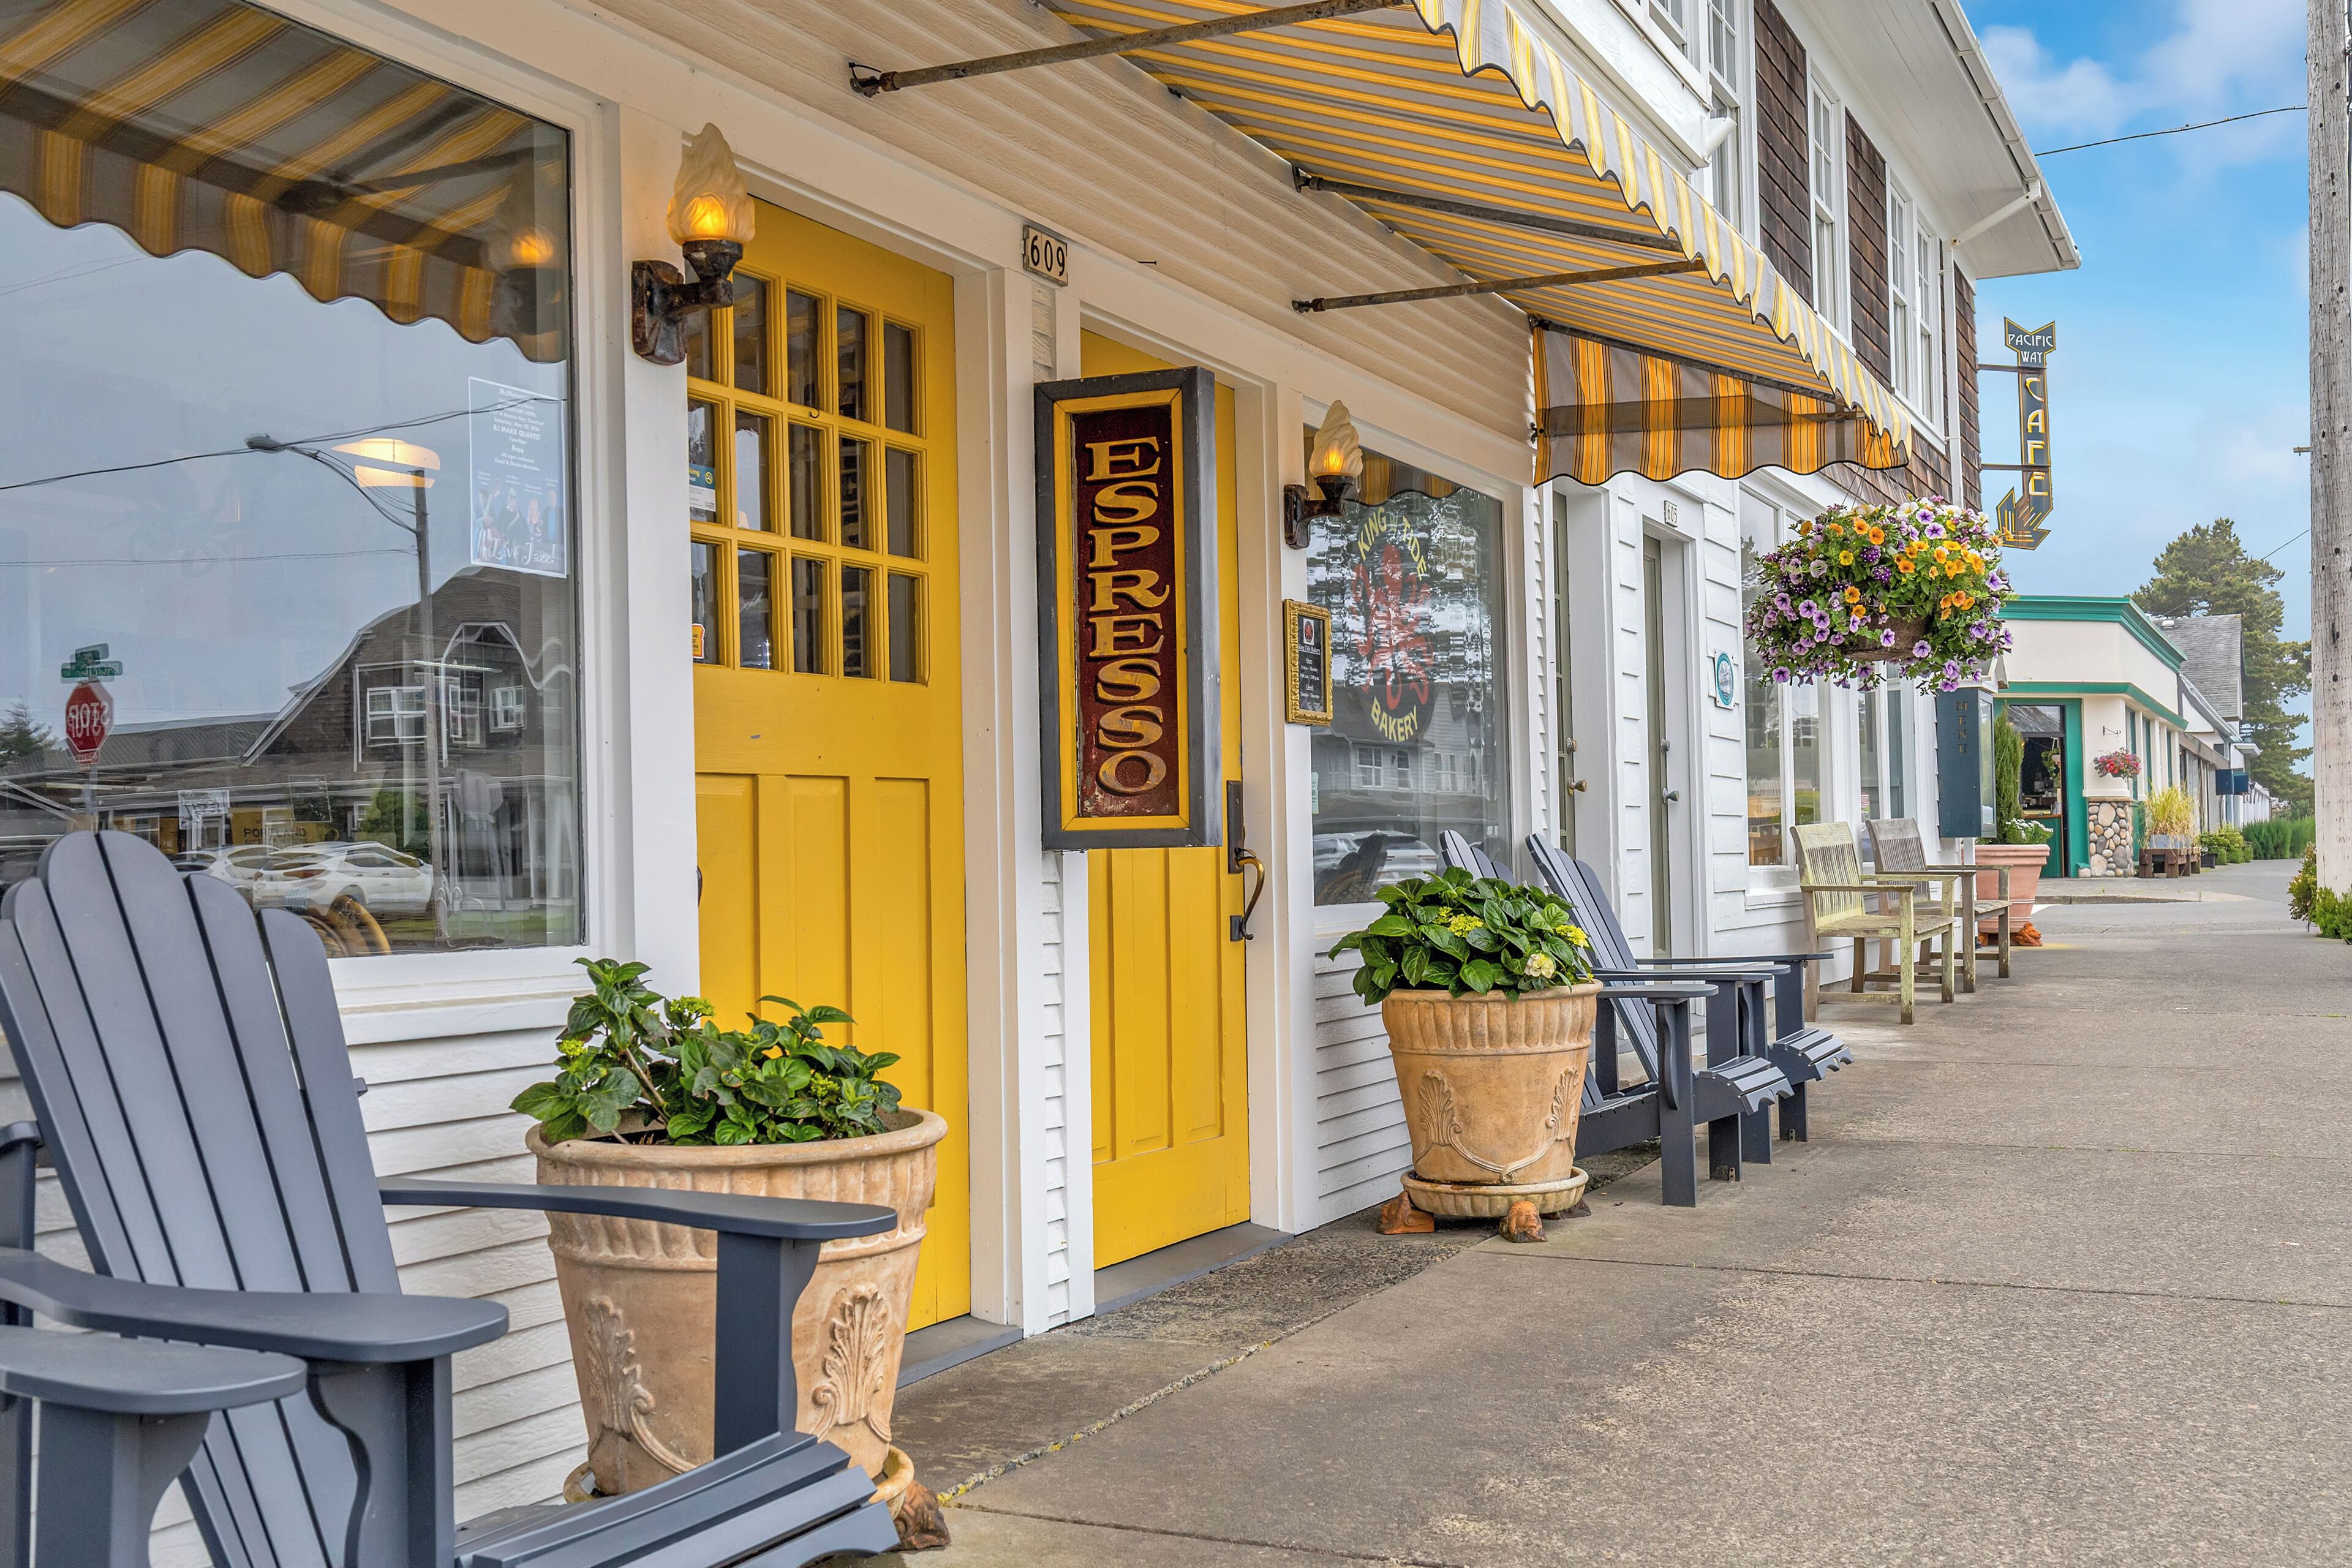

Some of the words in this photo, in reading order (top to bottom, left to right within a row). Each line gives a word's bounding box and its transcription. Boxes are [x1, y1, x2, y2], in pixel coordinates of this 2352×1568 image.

[1031, 235, 1065, 277] 609
[2008, 333, 2054, 347] PACIFIC
[2021, 350, 2043, 363] WAY
[501, 426, 518, 435] MARX
[518, 430, 541, 440] QUARTET
[2025, 377, 2049, 496] CAFE
[511, 445, 525, 454] Free
[1667, 504, 1678, 523] 605
[521, 542, 556, 565] Jazz!
[1357, 507, 1387, 562] KING
[1402, 515, 1427, 581] TIDE
[1085, 435, 1170, 794] ESPRESSO
[1371, 695, 1419, 743] BAKERY
[1956, 701, 1969, 755] MENU
